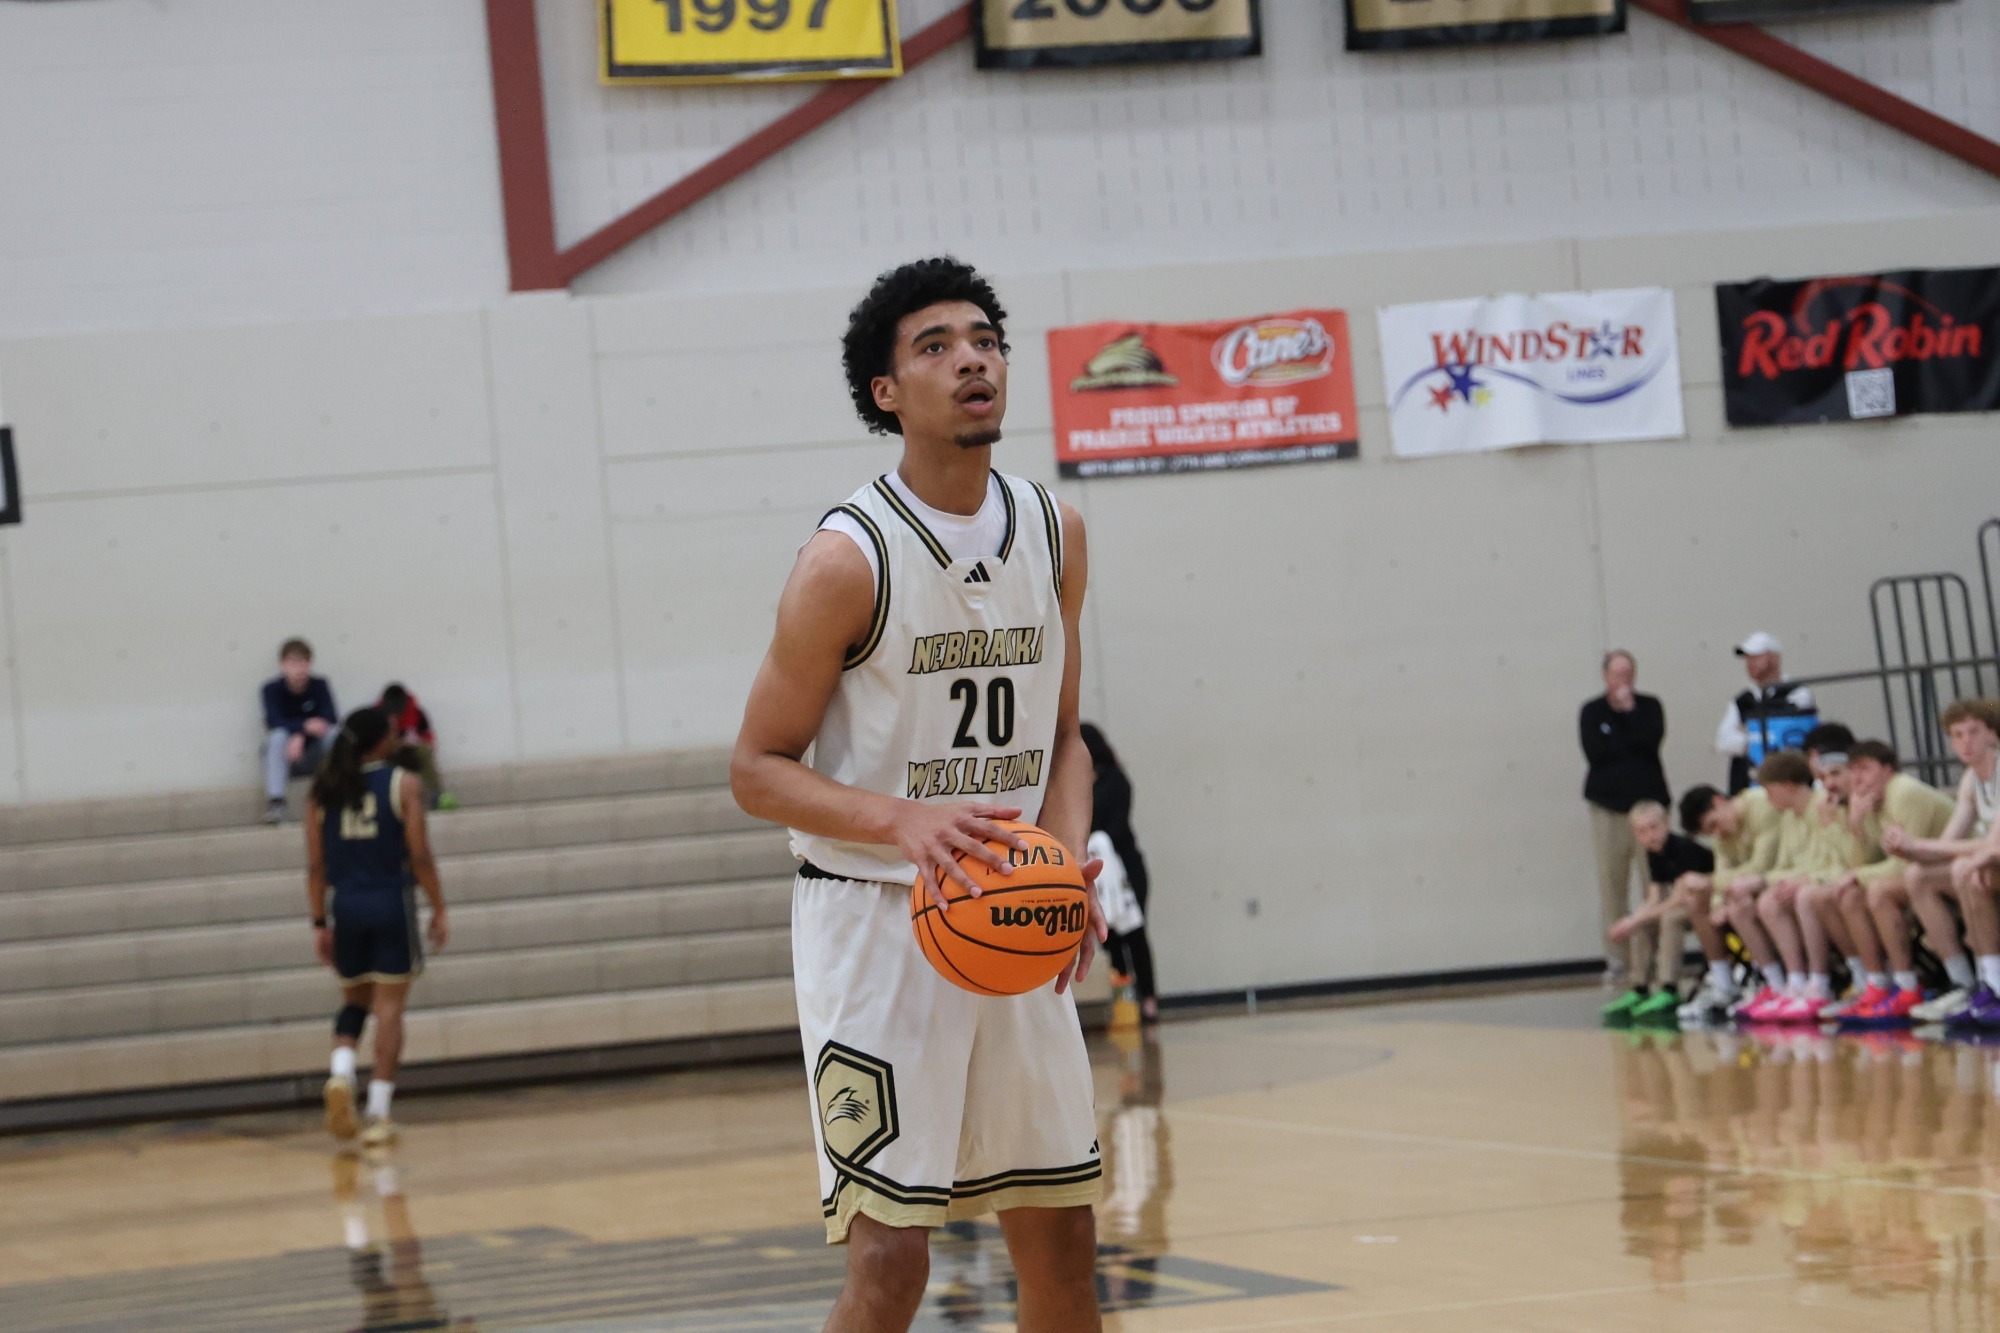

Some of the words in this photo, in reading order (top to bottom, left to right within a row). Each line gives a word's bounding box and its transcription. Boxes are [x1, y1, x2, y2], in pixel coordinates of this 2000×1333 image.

[1738, 310, 1842, 380] Red
[1843, 302, 1982, 372] Robin
[1111, 404, 1175, 426] PROUD
[1180, 399, 1268, 421] SPONSOR
[1273, 397, 1298, 416] OF
[1070, 429, 1148, 450] PRAIRIE
[1156, 424, 1231, 446] WOLVES
[1236, 413, 1341, 438] ATHLETICS
[950, 677, 1015, 748] 20
[990, 901, 1085, 936] Wilson
